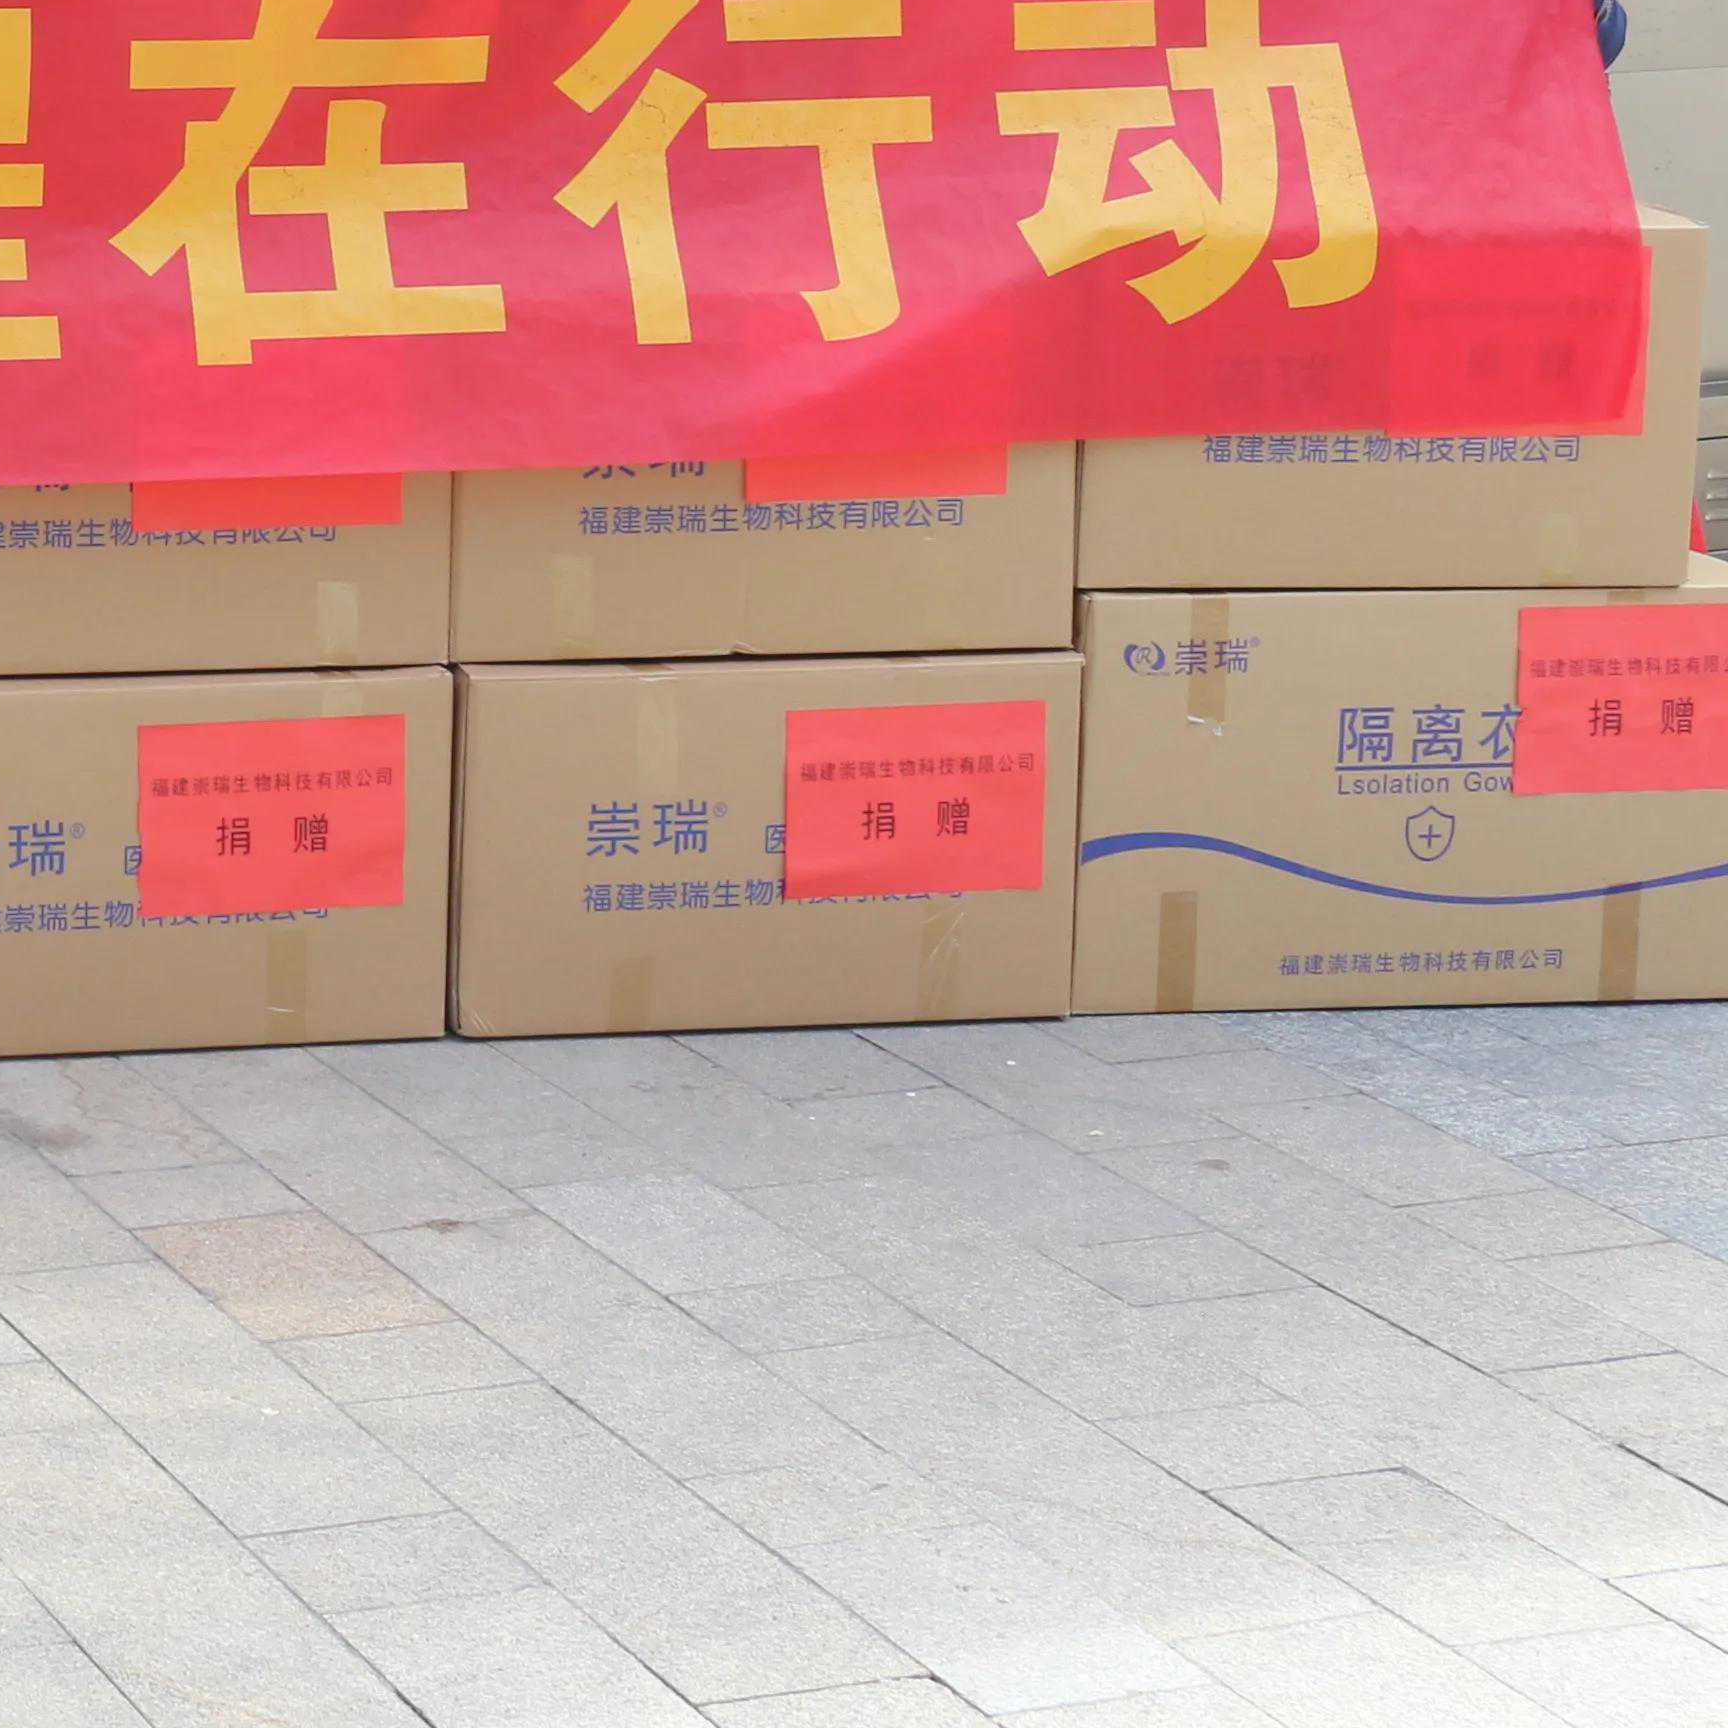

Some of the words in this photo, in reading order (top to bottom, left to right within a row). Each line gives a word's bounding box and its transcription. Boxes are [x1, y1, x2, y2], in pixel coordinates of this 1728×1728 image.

[1203, 434, 1580, 464] 福建崇瑞生物科技有限公司
[580, 498, 965, 536] 福建崇瑞生物科技有限公司
[1175, 641, 1250, 675] 崇瑞
[1530, 654, 1728, 679] 福建崇瑞生物科技有限
[1588, 697, 1694, 738] 捐赠
[151, 767, 393, 798] 福建崇瑞生物科技有限公司
[799, 752, 1035, 783] 福建崇瑞生物科技有限公司
[1337, 773, 1450, 797] Lsolation
[217, 813, 329, 857] 捐赠
[586, 798, 710, 856] 崇瑞
[861, 798, 971, 841] 捐赠
[1279, 950, 1564, 976] 福建崇瑞生物科技有限公司
